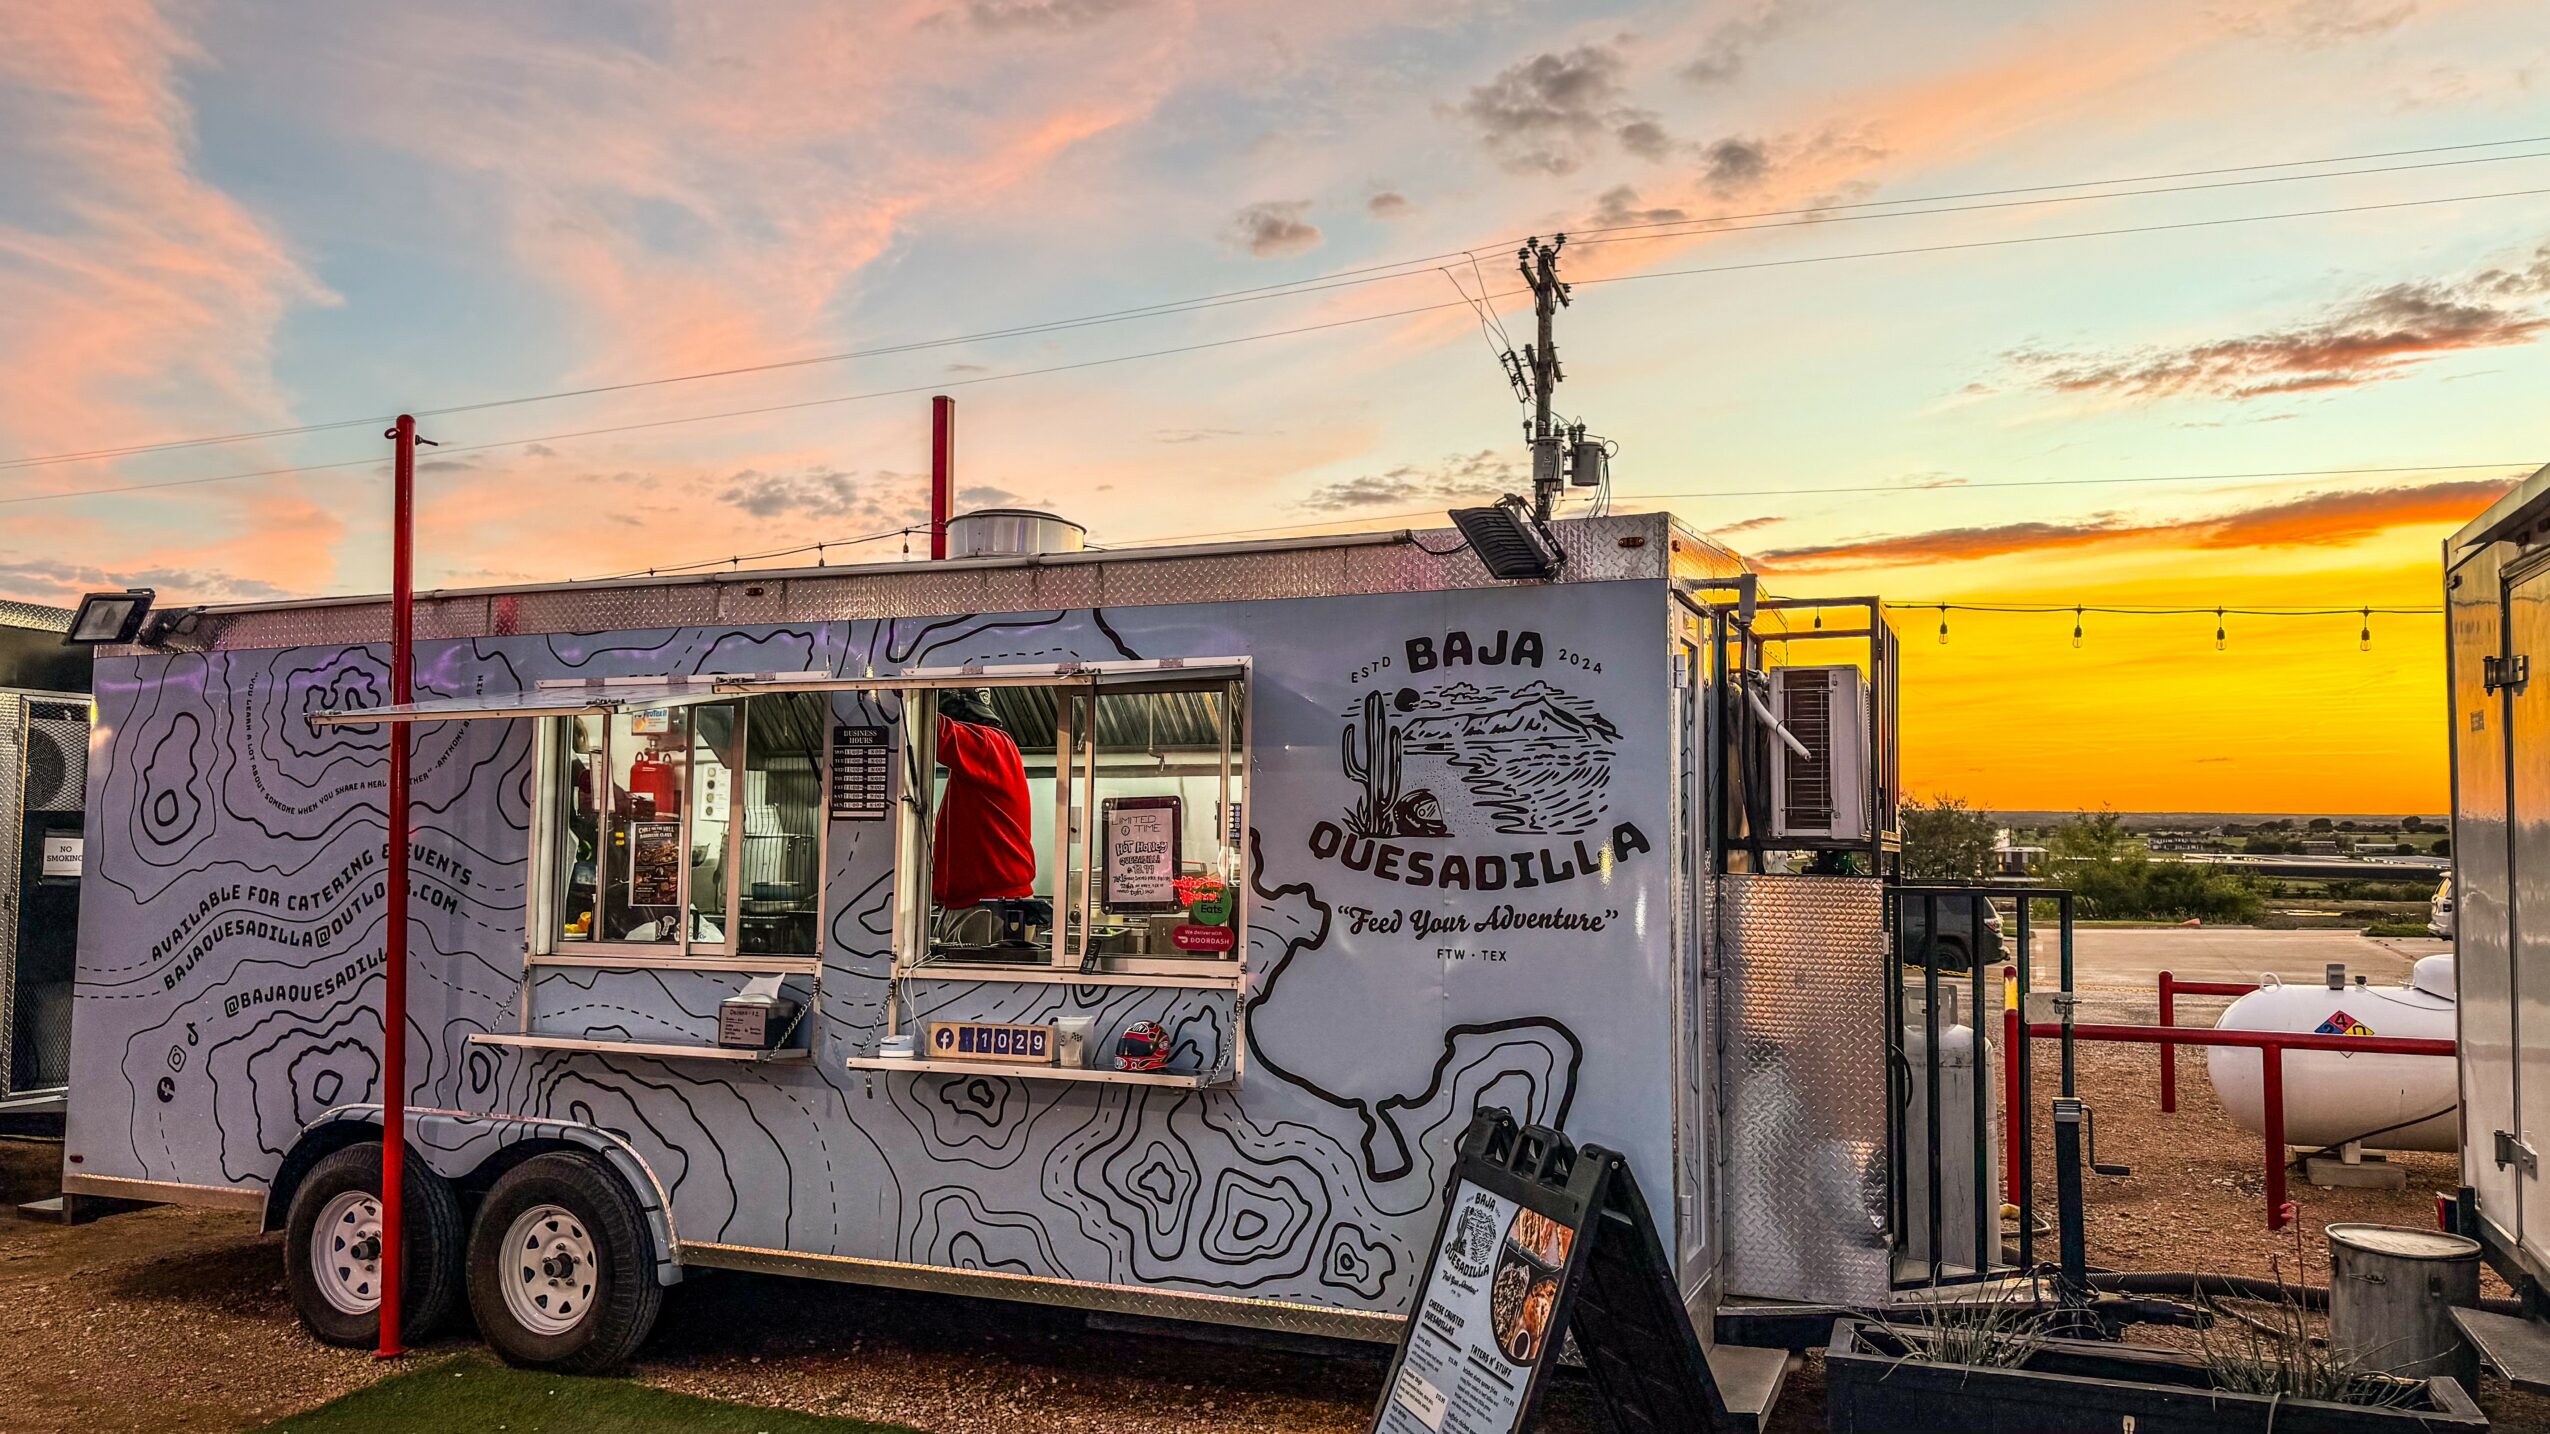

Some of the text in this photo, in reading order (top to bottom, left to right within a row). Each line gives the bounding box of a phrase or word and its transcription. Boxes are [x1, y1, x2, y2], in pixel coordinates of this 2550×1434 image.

[1405, 629, 1544, 674] BAJA
[1351, 656, 1391, 683] ESTD
[1558, 648, 1603, 675] 2024
[247, 743, 256, 761] LOT
[251, 765, 266, 792] ABOUT
[360, 781, 366, 790] A
[367, 780, 387, 789] MEAL
[318, 791, 334, 805] YOU
[335, 782, 359, 796] SHARE
[264, 793, 296, 815] SOMEONE
[297, 803, 319, 815] WHEN
[1112, 815, 1156, 825] LIMITED
[1134, 824, 1161, 833] TIME
[60, 845, 73, 853] NO
[1308, 821, 1651, 891] QUESADILLA
[152, 884, 241, 962] AVAILABLE
[248, 886, 280, 908] FOR
[287, 849, 374, 911] CATERING
[1201, 904, 1223, 914] Eats
[1409, 909, 1471, 940] Your
[1190, 937, 1230, 945] DOORDASH
[1436, 949, 1508, 962] FTW TEX
[2335, 1013, 2348, 1028] 4
[981, 1032, 1043, 1050] 1029
[1475, 1192, 1496, 1212] BAJA
[1444, 1241, 1490, 1279] QUESADILLA
[1428, 1299, 1465, 1328] CHEESE CRUSTED
[1424, 1310, 1455, 1337] QUESADILLAS
[1471, 1344, 1490, 1364] TATERS
[1495, 1360, 1512, 1378] STUFF
